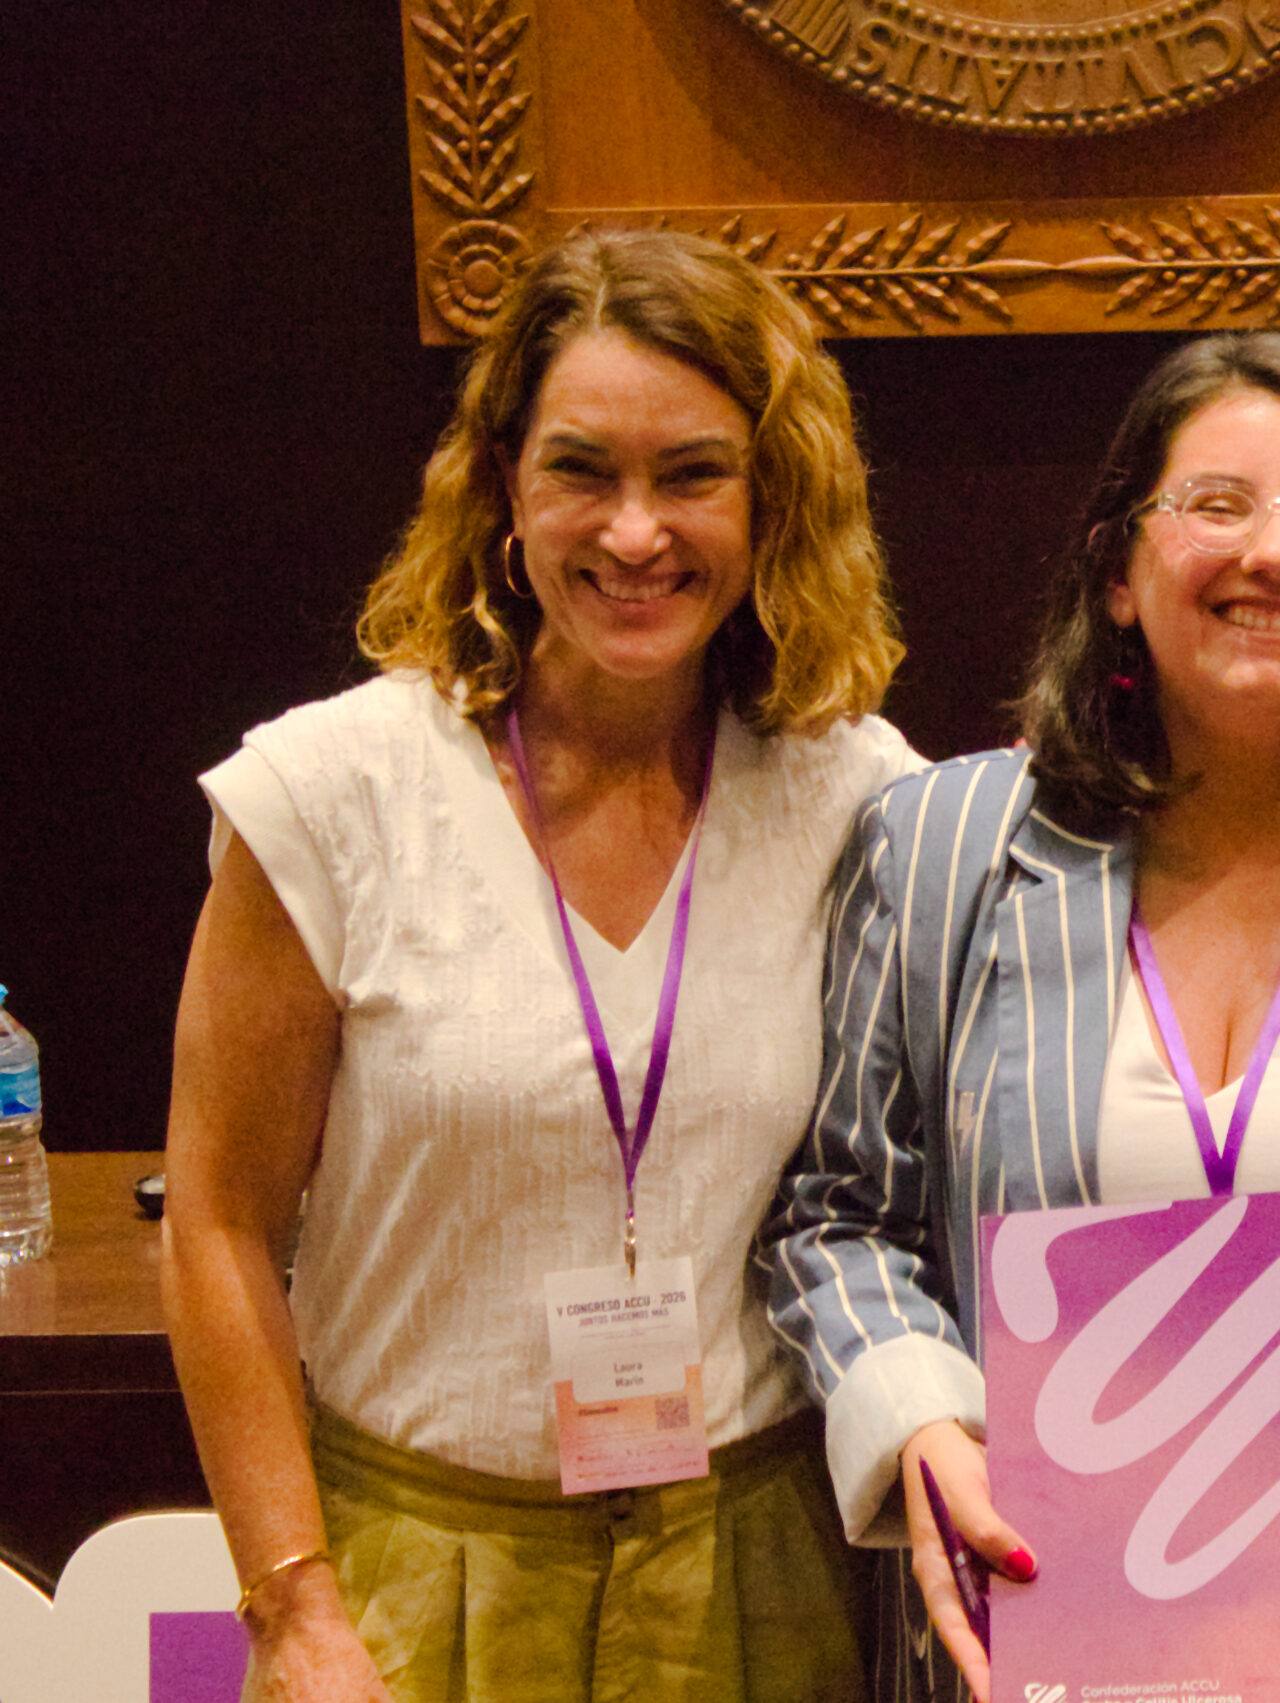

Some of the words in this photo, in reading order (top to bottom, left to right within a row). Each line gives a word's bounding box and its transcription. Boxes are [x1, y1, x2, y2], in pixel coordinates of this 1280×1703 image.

[566, 1299, 621, 1316] CONGRESO
[624, 1295, 651, 1309] ACCU
[613, 1362, 643, 1374] Laura
[1080, 1681, 1177, 1699] Confederación
[1179, 1679, 1220, 1692] ACCU
